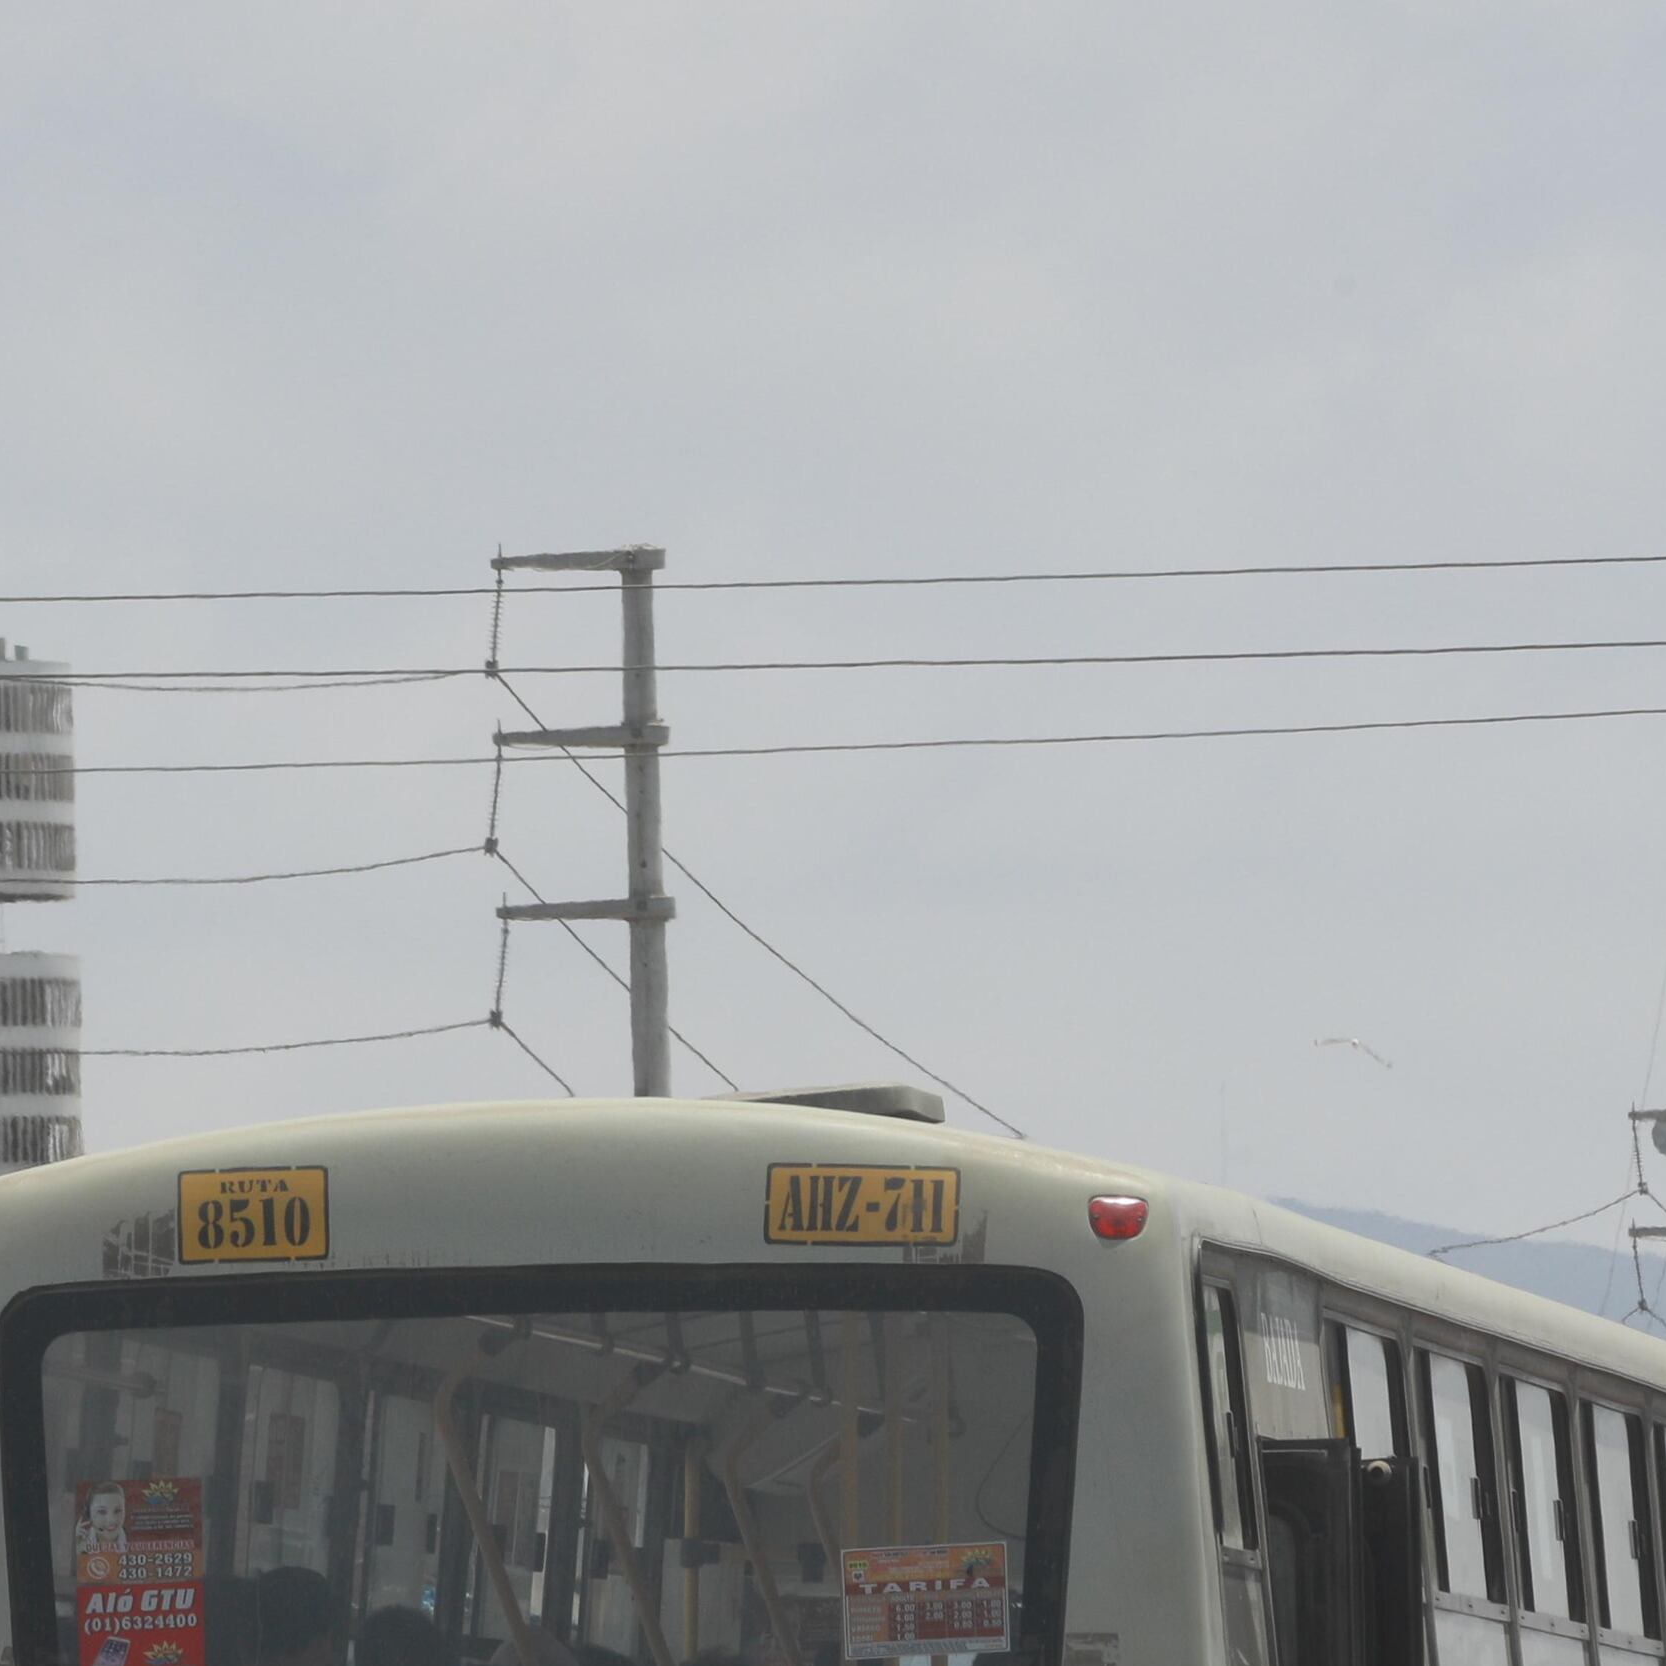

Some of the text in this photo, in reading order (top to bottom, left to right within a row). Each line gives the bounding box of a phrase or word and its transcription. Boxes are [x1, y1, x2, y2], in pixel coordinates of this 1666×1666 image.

[219, 1178, 290, 1194] RUTA
[778, 1174, 945, 1234] AHZ-711
[197, 1196, 310, 1250] 8510
[119, 1552, 193, 1566] 430-2629
[119, 1565, 193, 1579] 430-1472
[859, 1577, 990, 1594] TARIFA
[141, 1588, 195, 1612] GTU
[84, 1613, 198, 1635] (01)6324400
